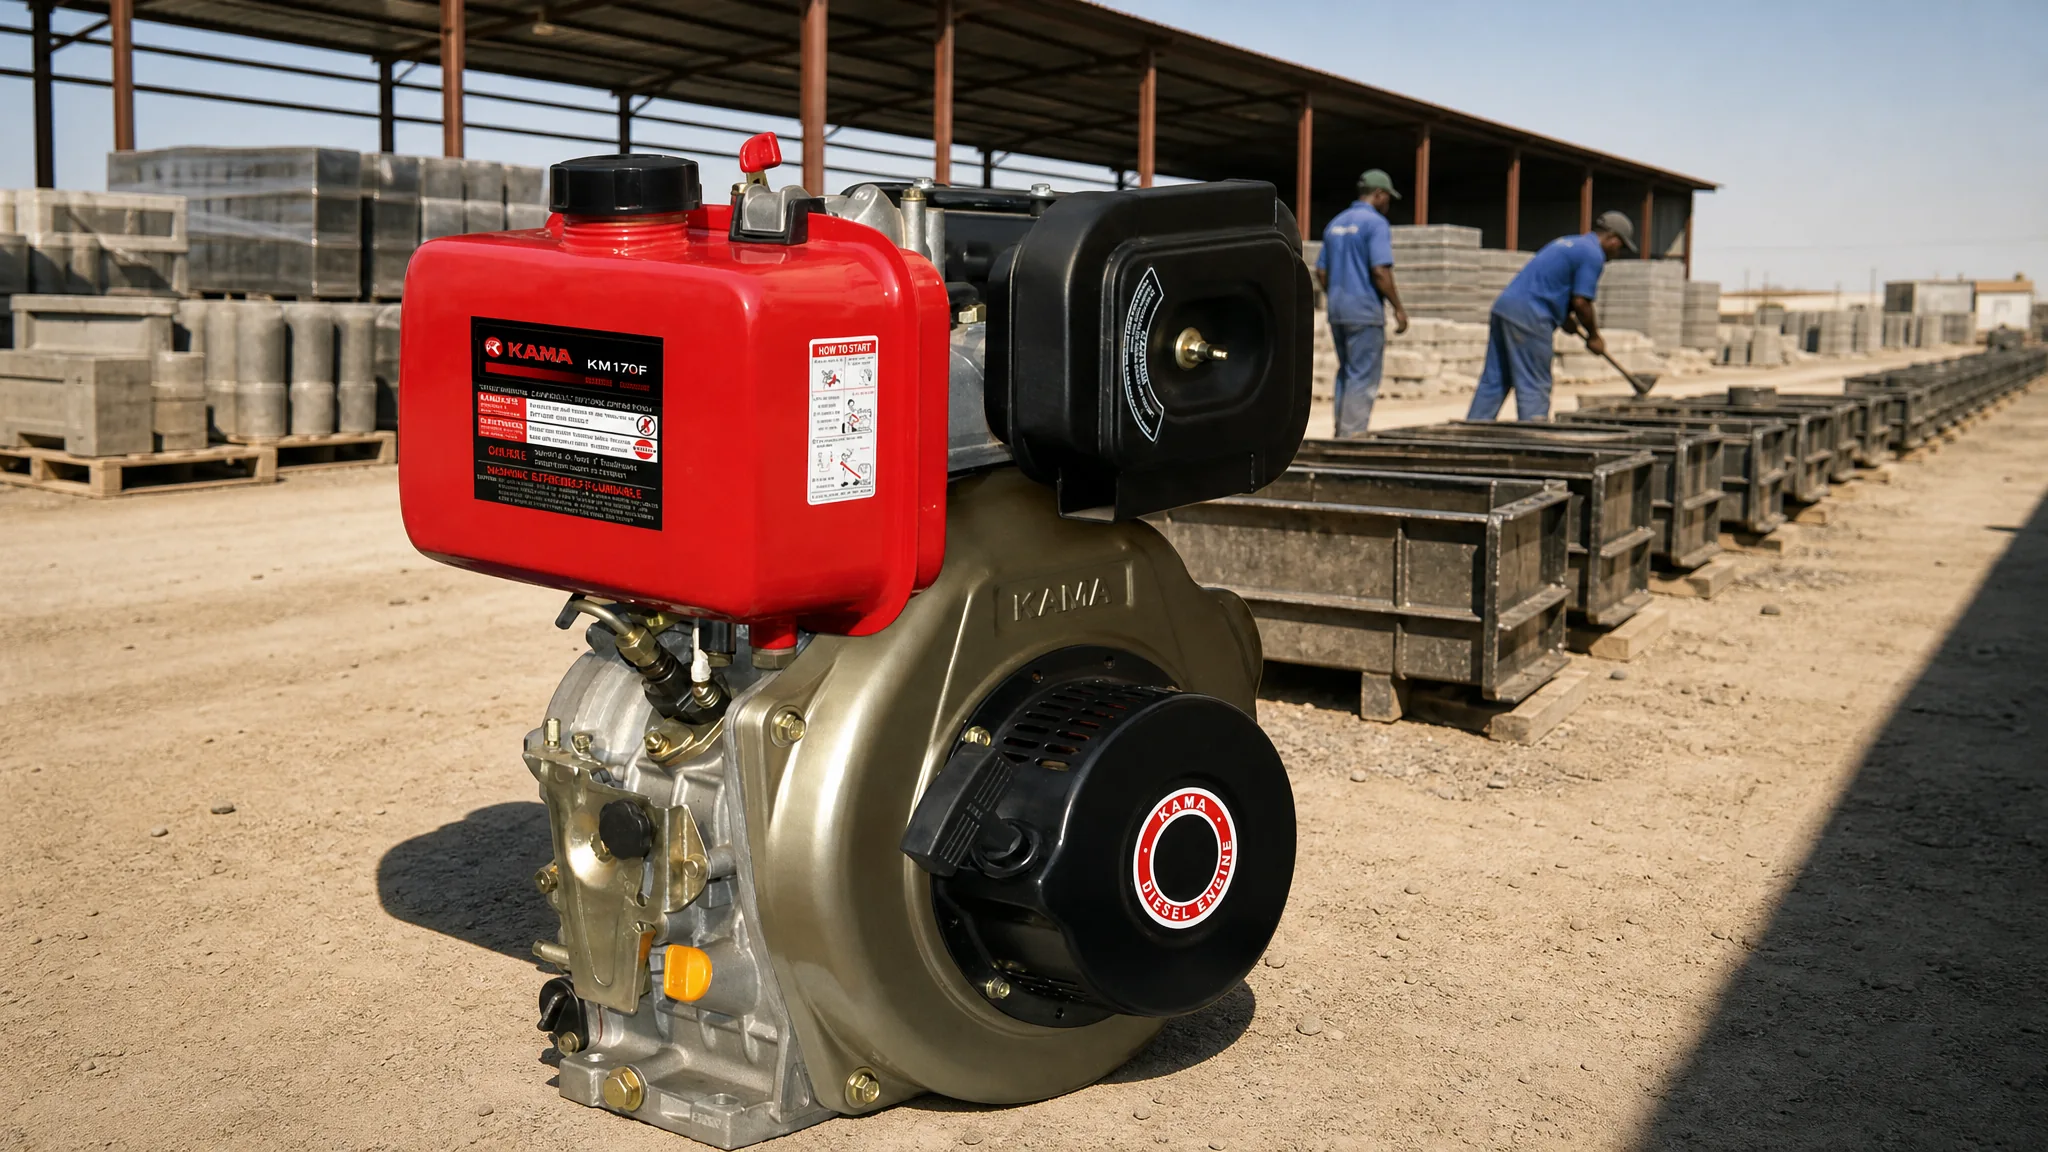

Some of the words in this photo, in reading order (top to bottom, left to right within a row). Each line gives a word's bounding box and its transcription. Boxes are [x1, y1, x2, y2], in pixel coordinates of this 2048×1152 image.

[508, 342, 573, 365] KAMA
[818, 345, 836, 355] HOW
[838, 344, 848, 354] TO
[849, 343, 872, 353] START
[587, 359, 648, 375] KM170F
[1013, 577, 1112, 621] KAMA
[1158, 796, 1206, 822] KAMA
[1142, 880, 1190, 919] DIESEL
[1197, 840, 1232, 912] ENGINE
